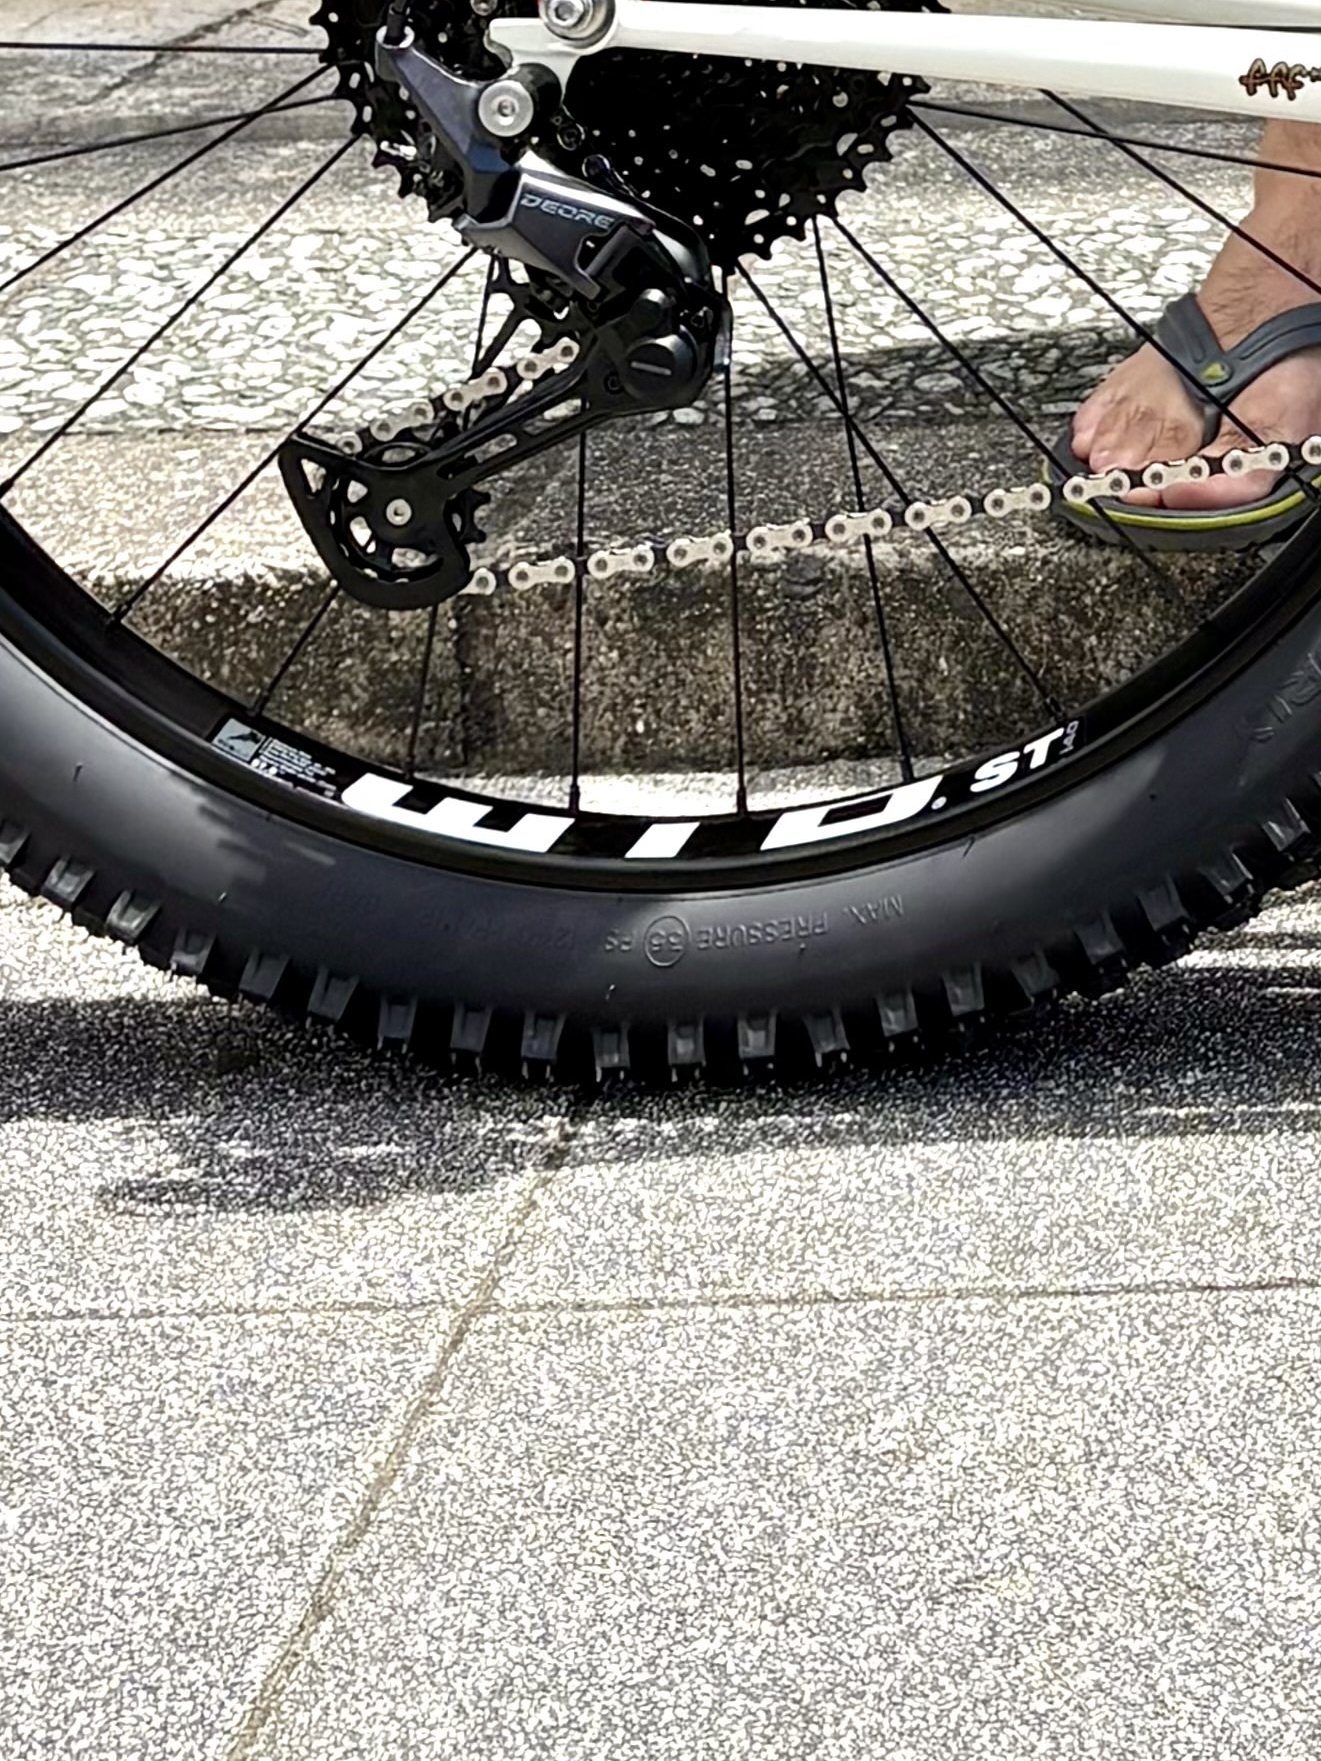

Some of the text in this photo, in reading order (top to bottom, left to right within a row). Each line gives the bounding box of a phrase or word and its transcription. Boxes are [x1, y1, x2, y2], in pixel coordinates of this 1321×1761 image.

[520, 194, 615, 229] DEORE
[970, 727, 1065, 793] ST
[697, 912, 829, 951] PRESSURE
